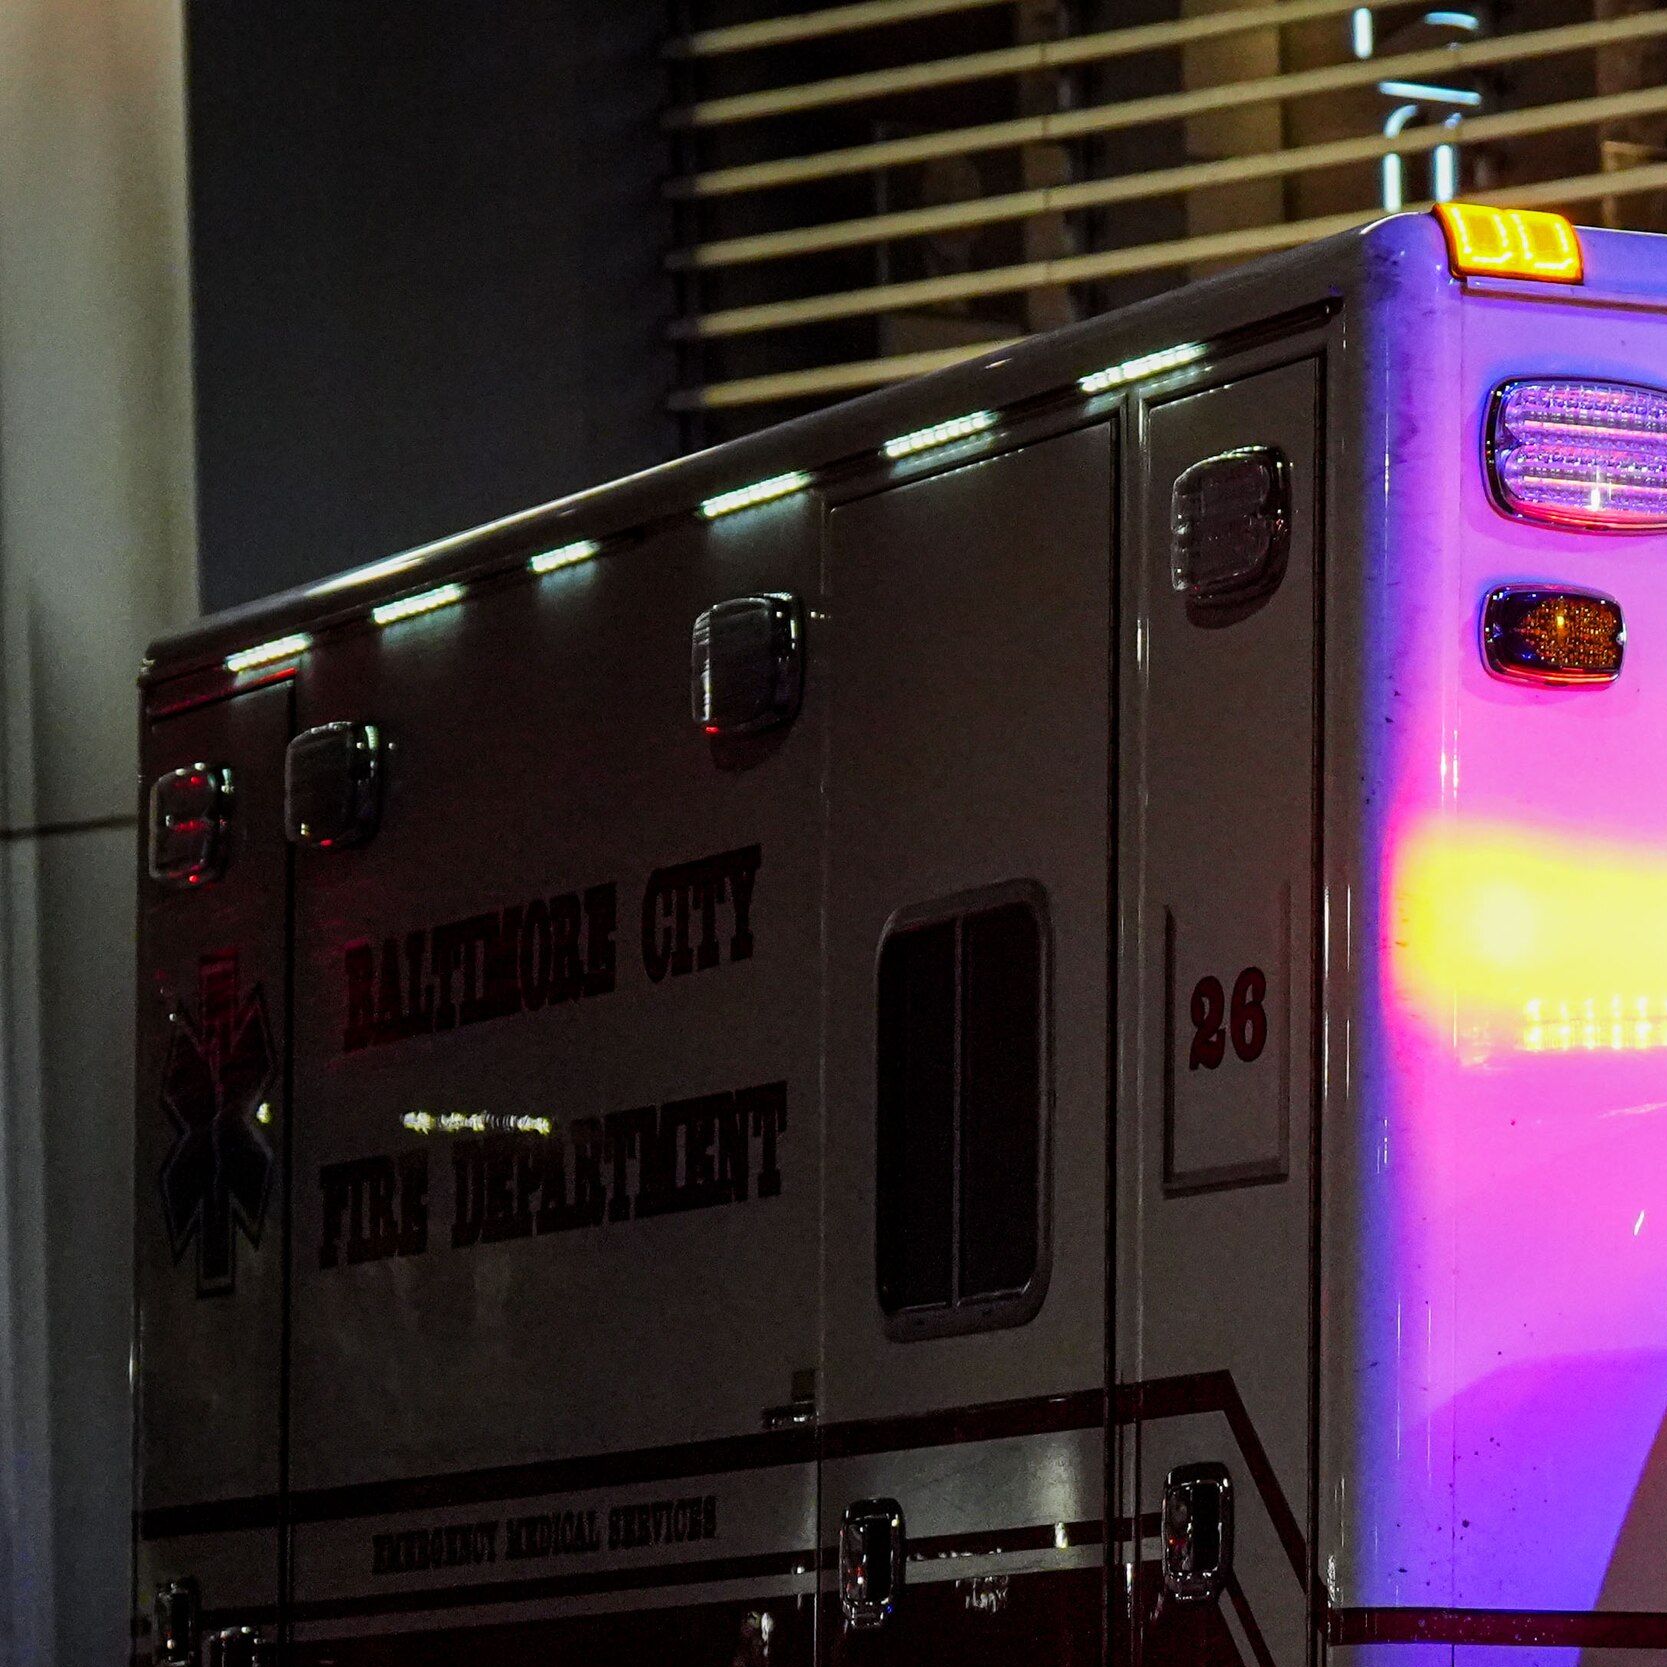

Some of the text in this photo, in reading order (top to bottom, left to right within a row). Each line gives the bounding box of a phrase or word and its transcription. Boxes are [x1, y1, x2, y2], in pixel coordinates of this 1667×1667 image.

[344, 843, 761, 1052] BALTIMORE CITY
[1190, 967, 1267, 1070] 26
[319, 1080, 787, 1270] FIRE DEPARTMENT
[372, 1495, 716, 1575] EMERGENCY MEDICAL SERVICES
